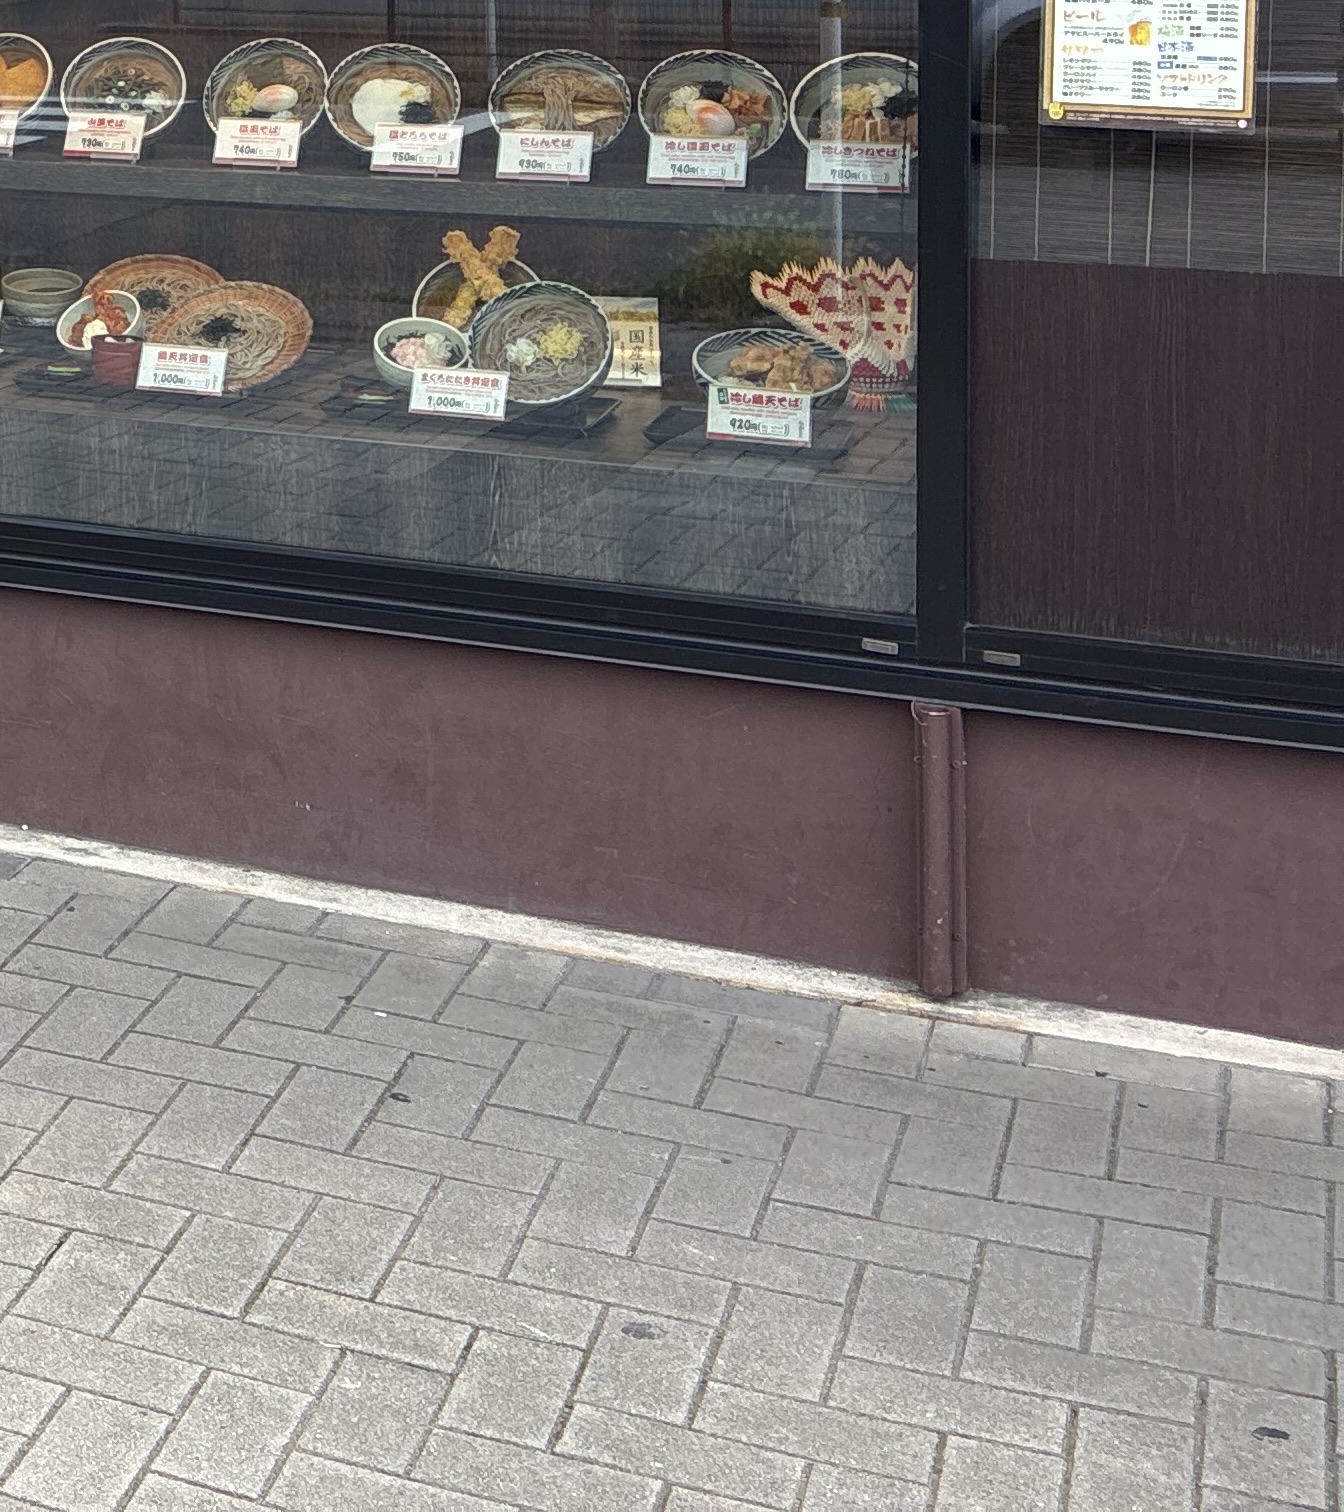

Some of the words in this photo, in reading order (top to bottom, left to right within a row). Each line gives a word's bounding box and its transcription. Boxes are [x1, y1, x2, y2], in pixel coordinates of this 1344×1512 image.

[519, 136, 575, 149] にしんそば
[628, 329, 649, 378] 国産米
